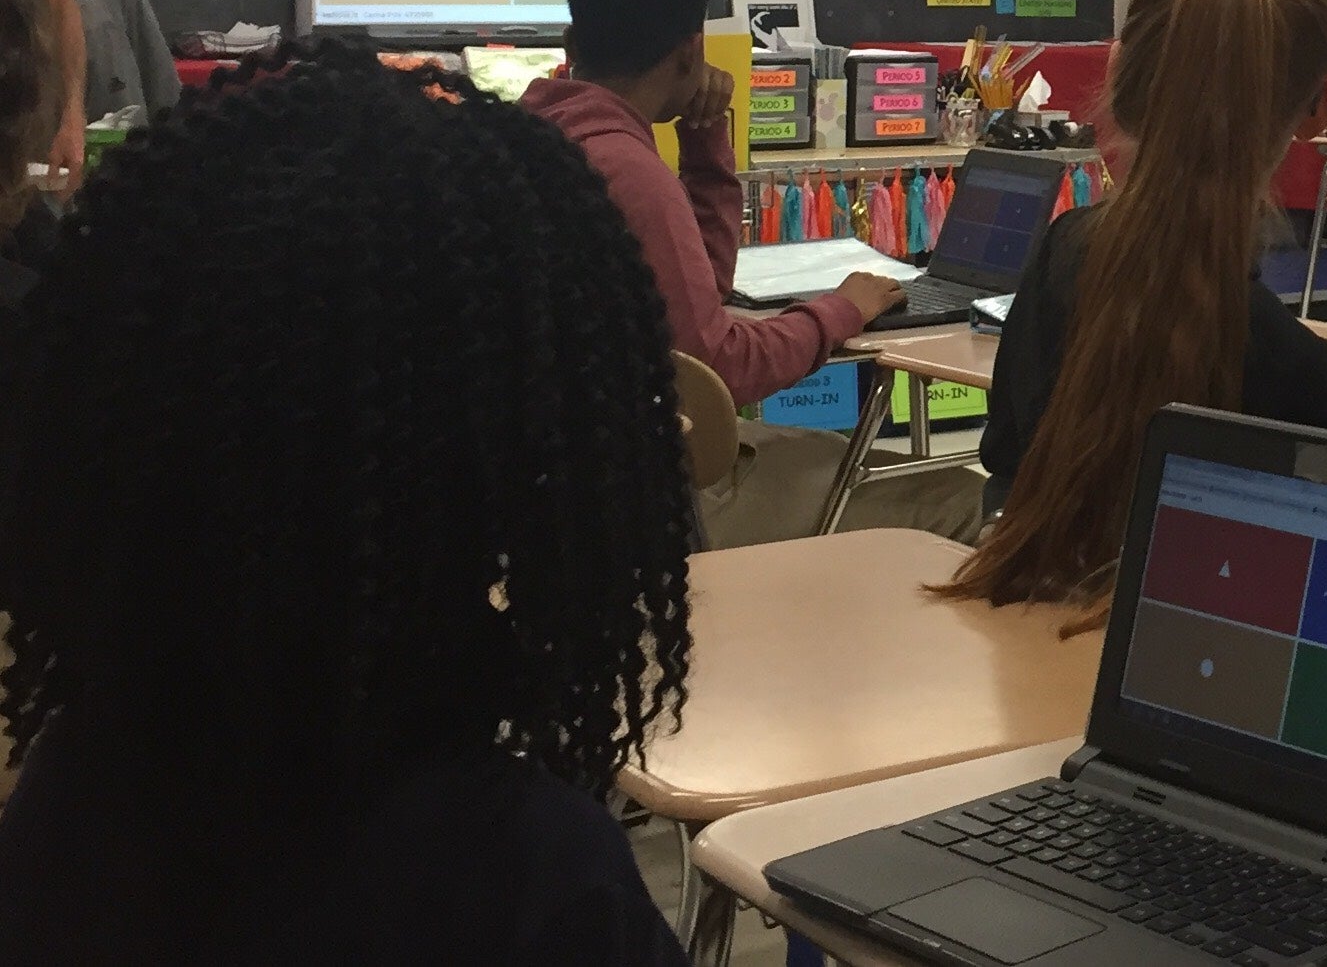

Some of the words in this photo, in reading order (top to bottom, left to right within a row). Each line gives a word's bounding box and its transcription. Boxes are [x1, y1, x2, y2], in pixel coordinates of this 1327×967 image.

[749, 74, 782, 84] PERIOD
[783, 75, 791, 83] 2
[882, 71, 913, 80] PERIOD
[914, 71, 921, 79] 5
[750, 98, 781, 110] PERIOD
[783, 98, 789, 109] 3
[880, 98, 911, 108] PERIOD
[912, 98, 919, 106] 6
[749, 126, 783, 136] PERIOD
[784, 126, 791, 135] 4
[882, 122, 913, 132] PERIOD
[914, 122, 921, 130] 7
[778, 392, 839, 408] TURN-IN
[927, 387, 968, 404] RN-IN
